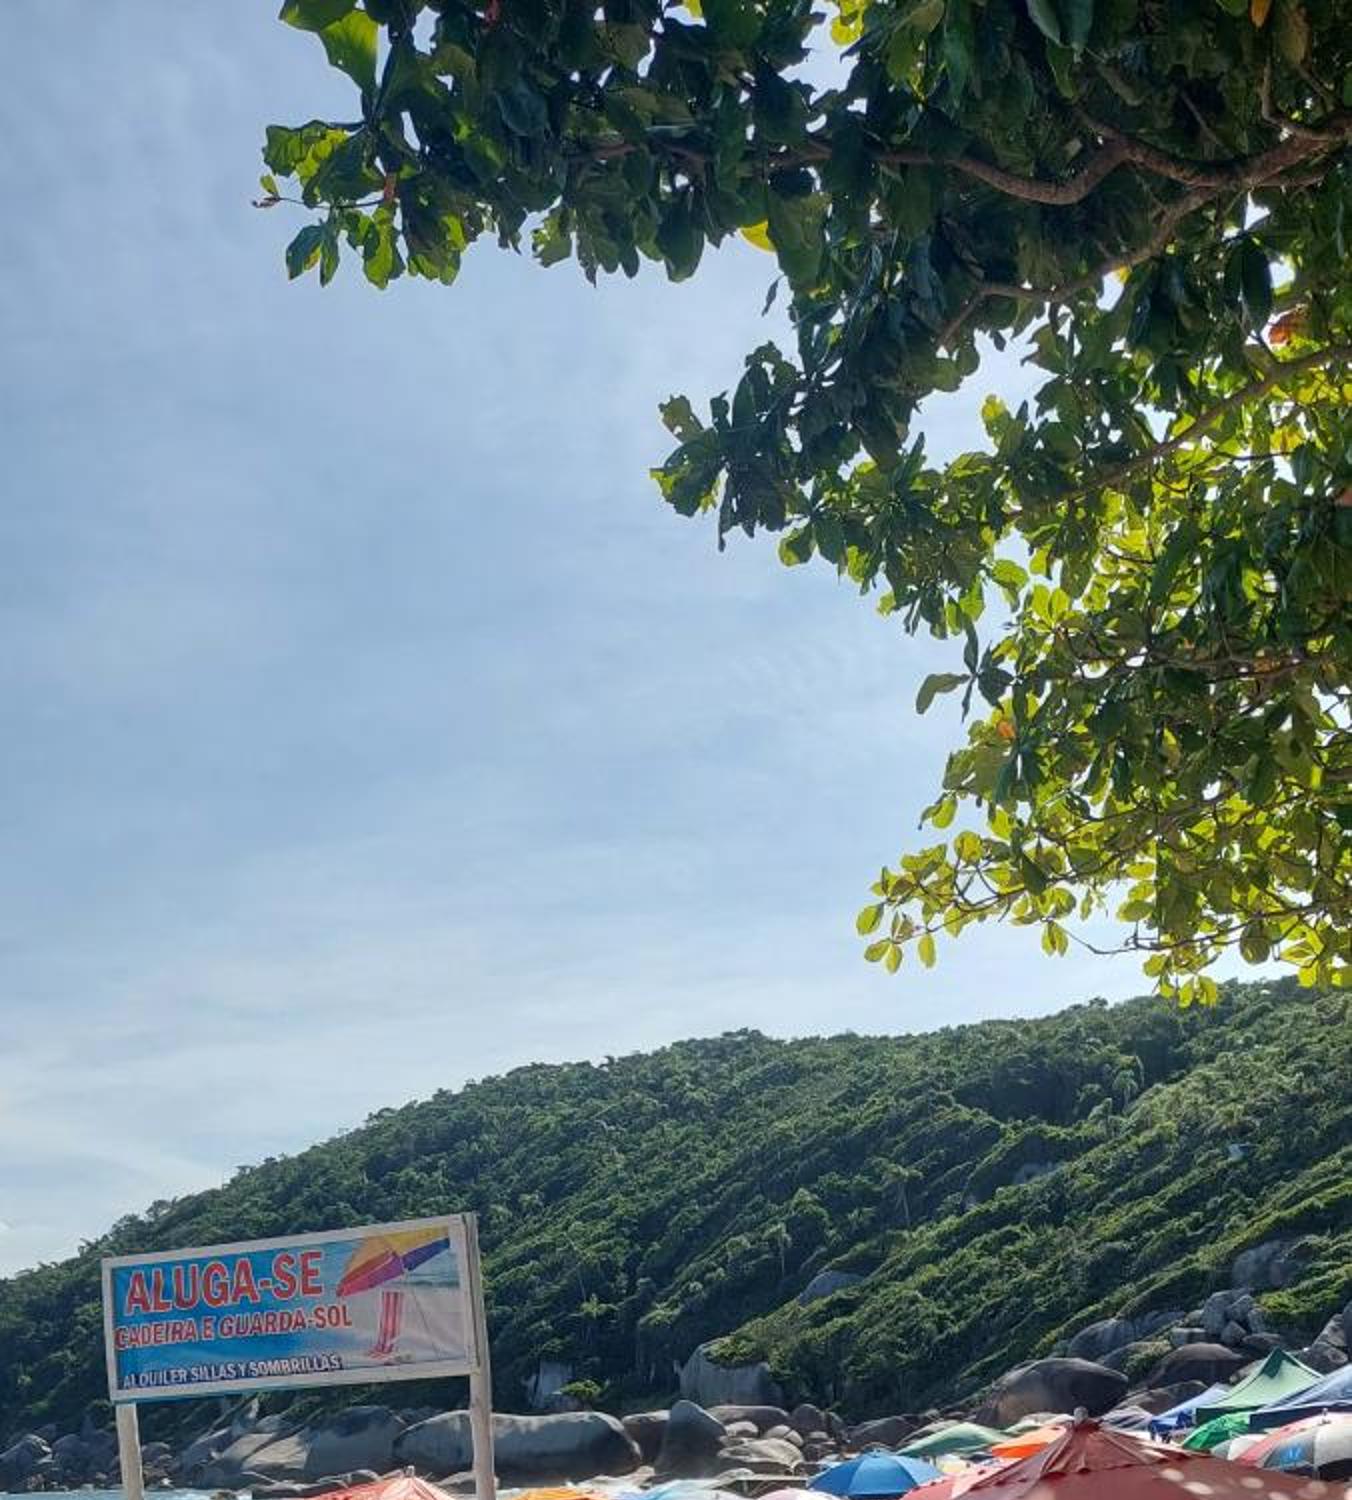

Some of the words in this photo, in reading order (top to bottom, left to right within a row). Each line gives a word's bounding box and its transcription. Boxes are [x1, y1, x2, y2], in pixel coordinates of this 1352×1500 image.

[125, 1251, 324, 1315] ALUGA-SE
[114, 1318, 197, 1349] CADEIRA
[201, 1316, 216, 1341] E
[218, 1304, 353, 1338] GUARDA-SOL
[123, 1367, 187, 1389] ALQUILER
[190, 1363, 236, 1382] SILLAS
[237, 1363, 247, 1377] Y
[249, 1354, 342, 1377] SOMBRILLAS
